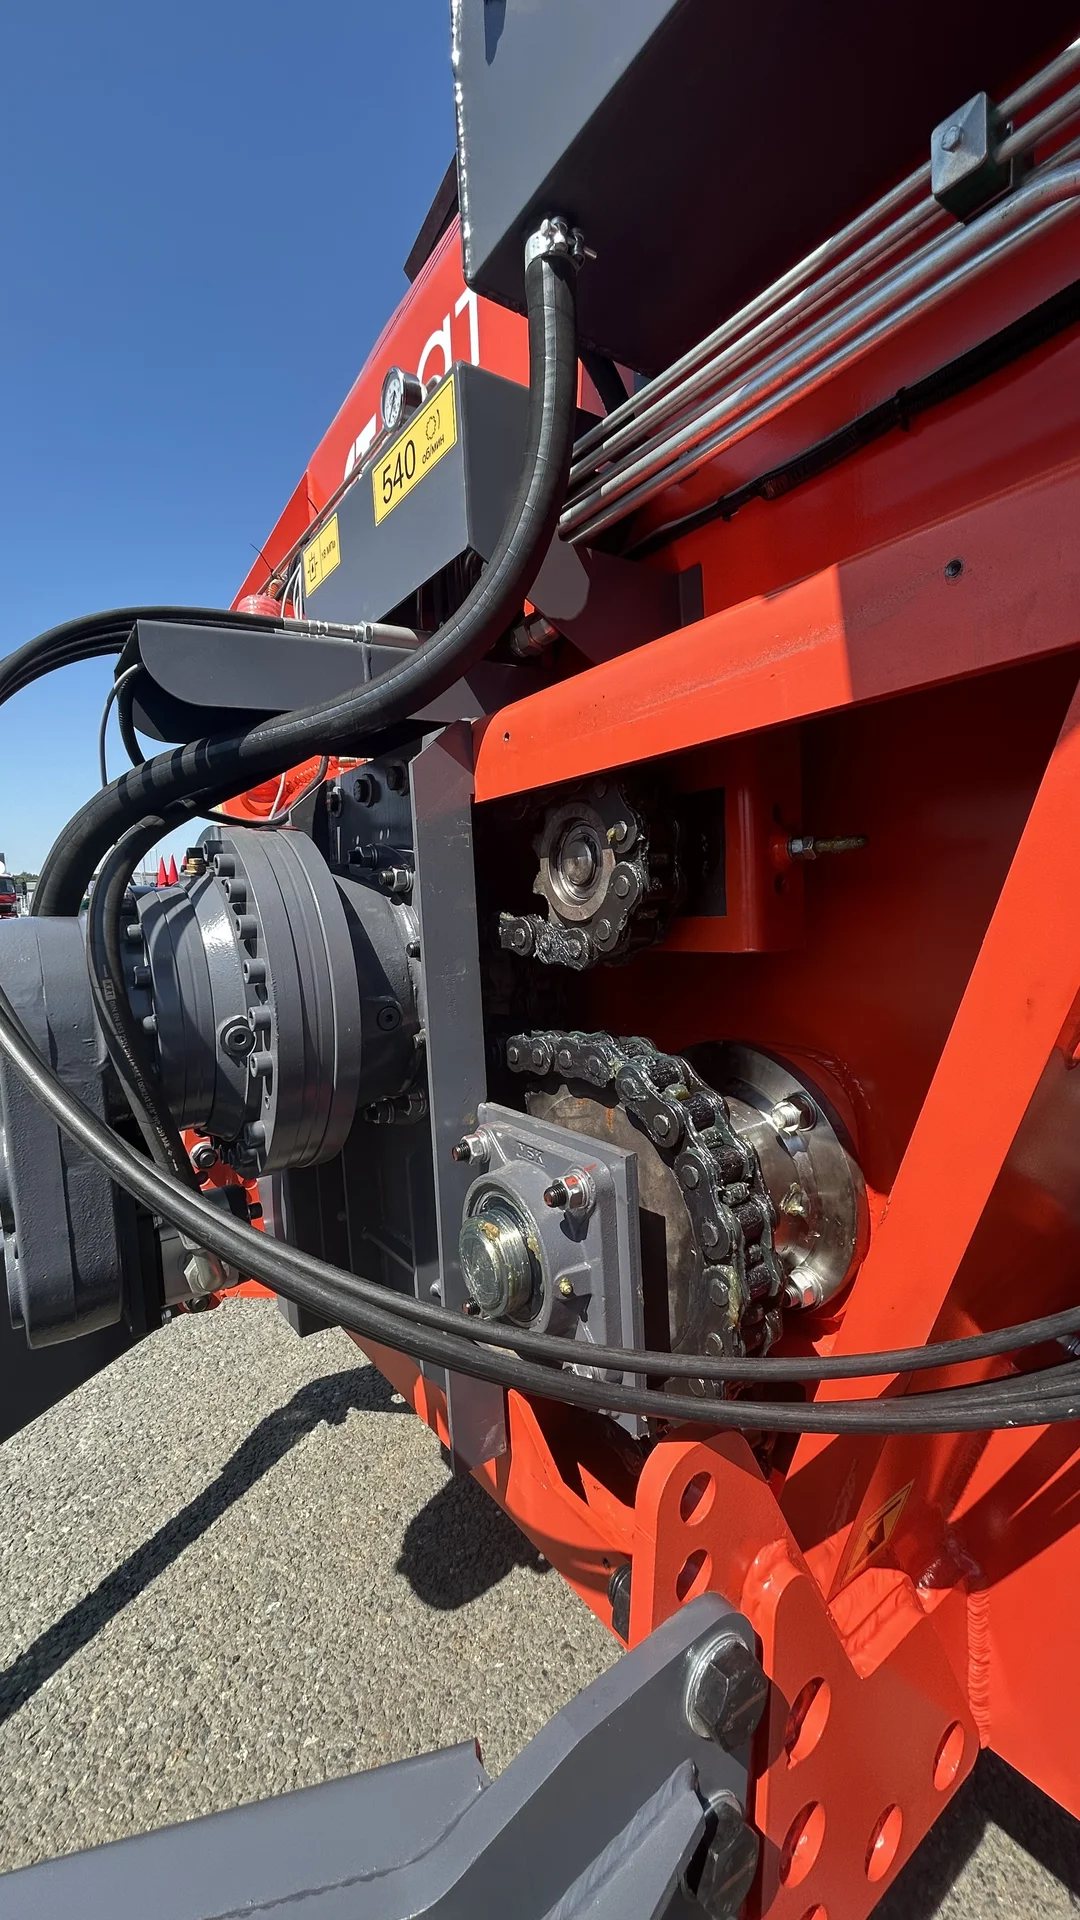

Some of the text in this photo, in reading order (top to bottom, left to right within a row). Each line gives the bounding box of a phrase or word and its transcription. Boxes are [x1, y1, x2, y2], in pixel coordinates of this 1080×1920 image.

[383, 434, 445, 504] 540 об/мин
[104, 981, 114, 998] KRT
[109, 1001, 118, 1012] DIN
[113, 1012, 121, 1022] EN
[115, 1022, 125, 1034] 853
[161, 1136, 170, 1148] BAR
